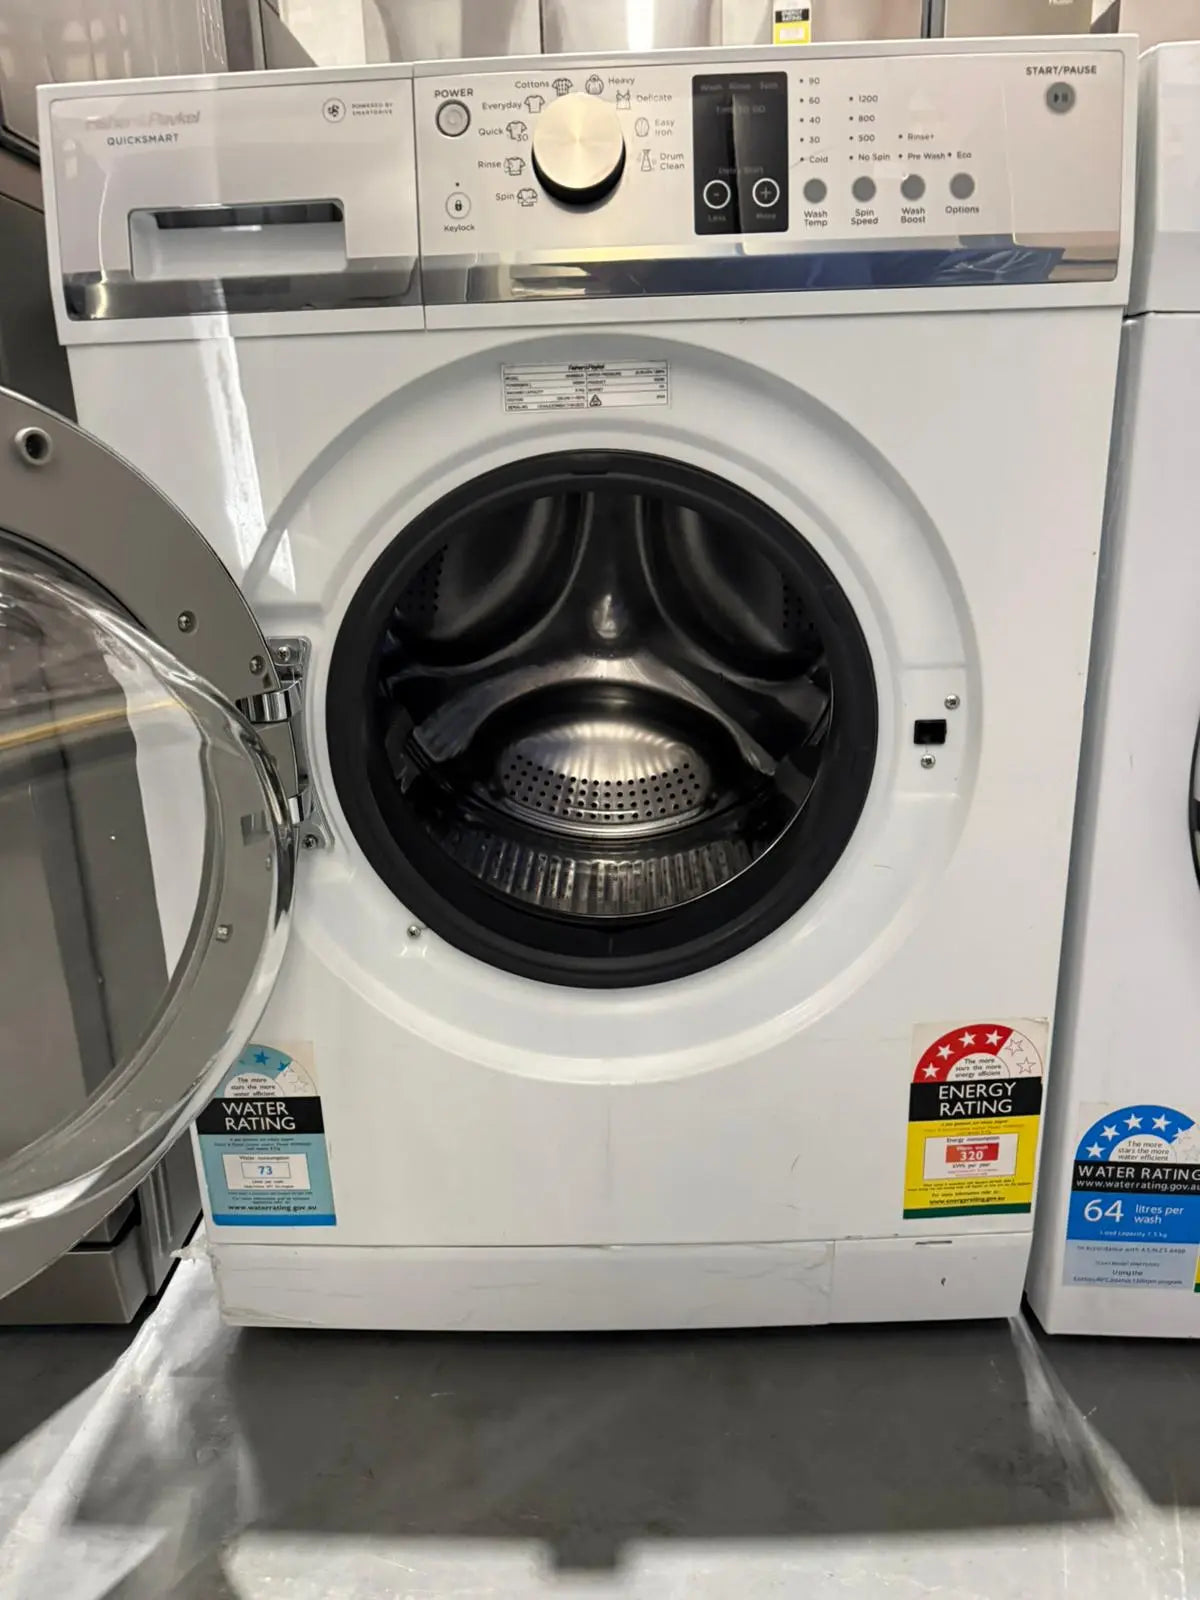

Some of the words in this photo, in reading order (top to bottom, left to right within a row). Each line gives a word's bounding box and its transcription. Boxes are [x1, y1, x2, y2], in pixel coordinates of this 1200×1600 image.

[1025, 65, 1097, 76] START/PAUSE
[515, 79, 549, 90] Cottons
[608, 76, 635, 87] Heavy
[808, 76, 821, 86] 90
[434, 87, 474, 98] POWER
[636, 92, 672, 103] Delicate
[808, 95, 821, 105] 60
[858, 94, 878, 104] 1200
[482, 100, 522, 112] Everyday
[655, 118, 675, 129] Easy
[809, 115, 821, 125] 40
[858, 114, 876, 123] 800
[478, 127, 504, 138] Quick
[655, 127, 673, 137] Iron
[907, 131, 935, 142] Rinse+
[106, 132, 179, 147] QUICKSMART
[809, 134, 821, 144] 30
[858, 133, 876, 143] 500
[660, 151, 685, 161] Drum
[809, 154, 828, 164] Cold
[858, 152, 871, 162] No
[871, 152, 891, 163] Spin
[907, 152, 921, 162] Pre
[922, 151, 946, 162] Wash
[956, 150, 972, 160] Eco
[478, 159, 502, 170] Rinse
[660, 160, 686, 171] Clean
[496, 191, 515, 203] Spin
[804, 209, 828, 219] Wash
[855, 208, 875, 220] Spin
[901, 206, 926, 216] Wash
[945, 204, 980, 216] Options
[804, 218, 828, 228] Temp
[850, 216, 879, 227] Speed
[900, 215, 926, 225] Boost
[443, 223, 475, 233] Keylock
[955, 1071, 976, 1079] energy
[938, 1081, 1017, 1100] ENERGY
[222, 1101, 290, 1116] WATER
[939, 1100, 1013, 1116] RATING
[225, 1116, 296, 1132] RATING
[1127, 1139, 1141, 1148] The
[960, 1151, 984, 1161] 320
[1117, 1147, 1137, 1155] stars
[1137, 1147, 1149, 1155] the
[1117, 1153, 1138, 1161] water
[1140, 1153, 1169, 1162] efficient
[257, 1165, 273, 1176] 73
[1077, 1164, 1135, 1179] WATER
[1141, 1167, 1200, 1181] RATING
[1075, 1179, 1200, 1192] www.waterrating.gov.au
[1083, 1197, 1124, 1224] 64
[1135, 1203, 1163, 1215] litres
[1164, 1204, 1185, 1217] per
[1134, 1214, 1163, 1225] wash
